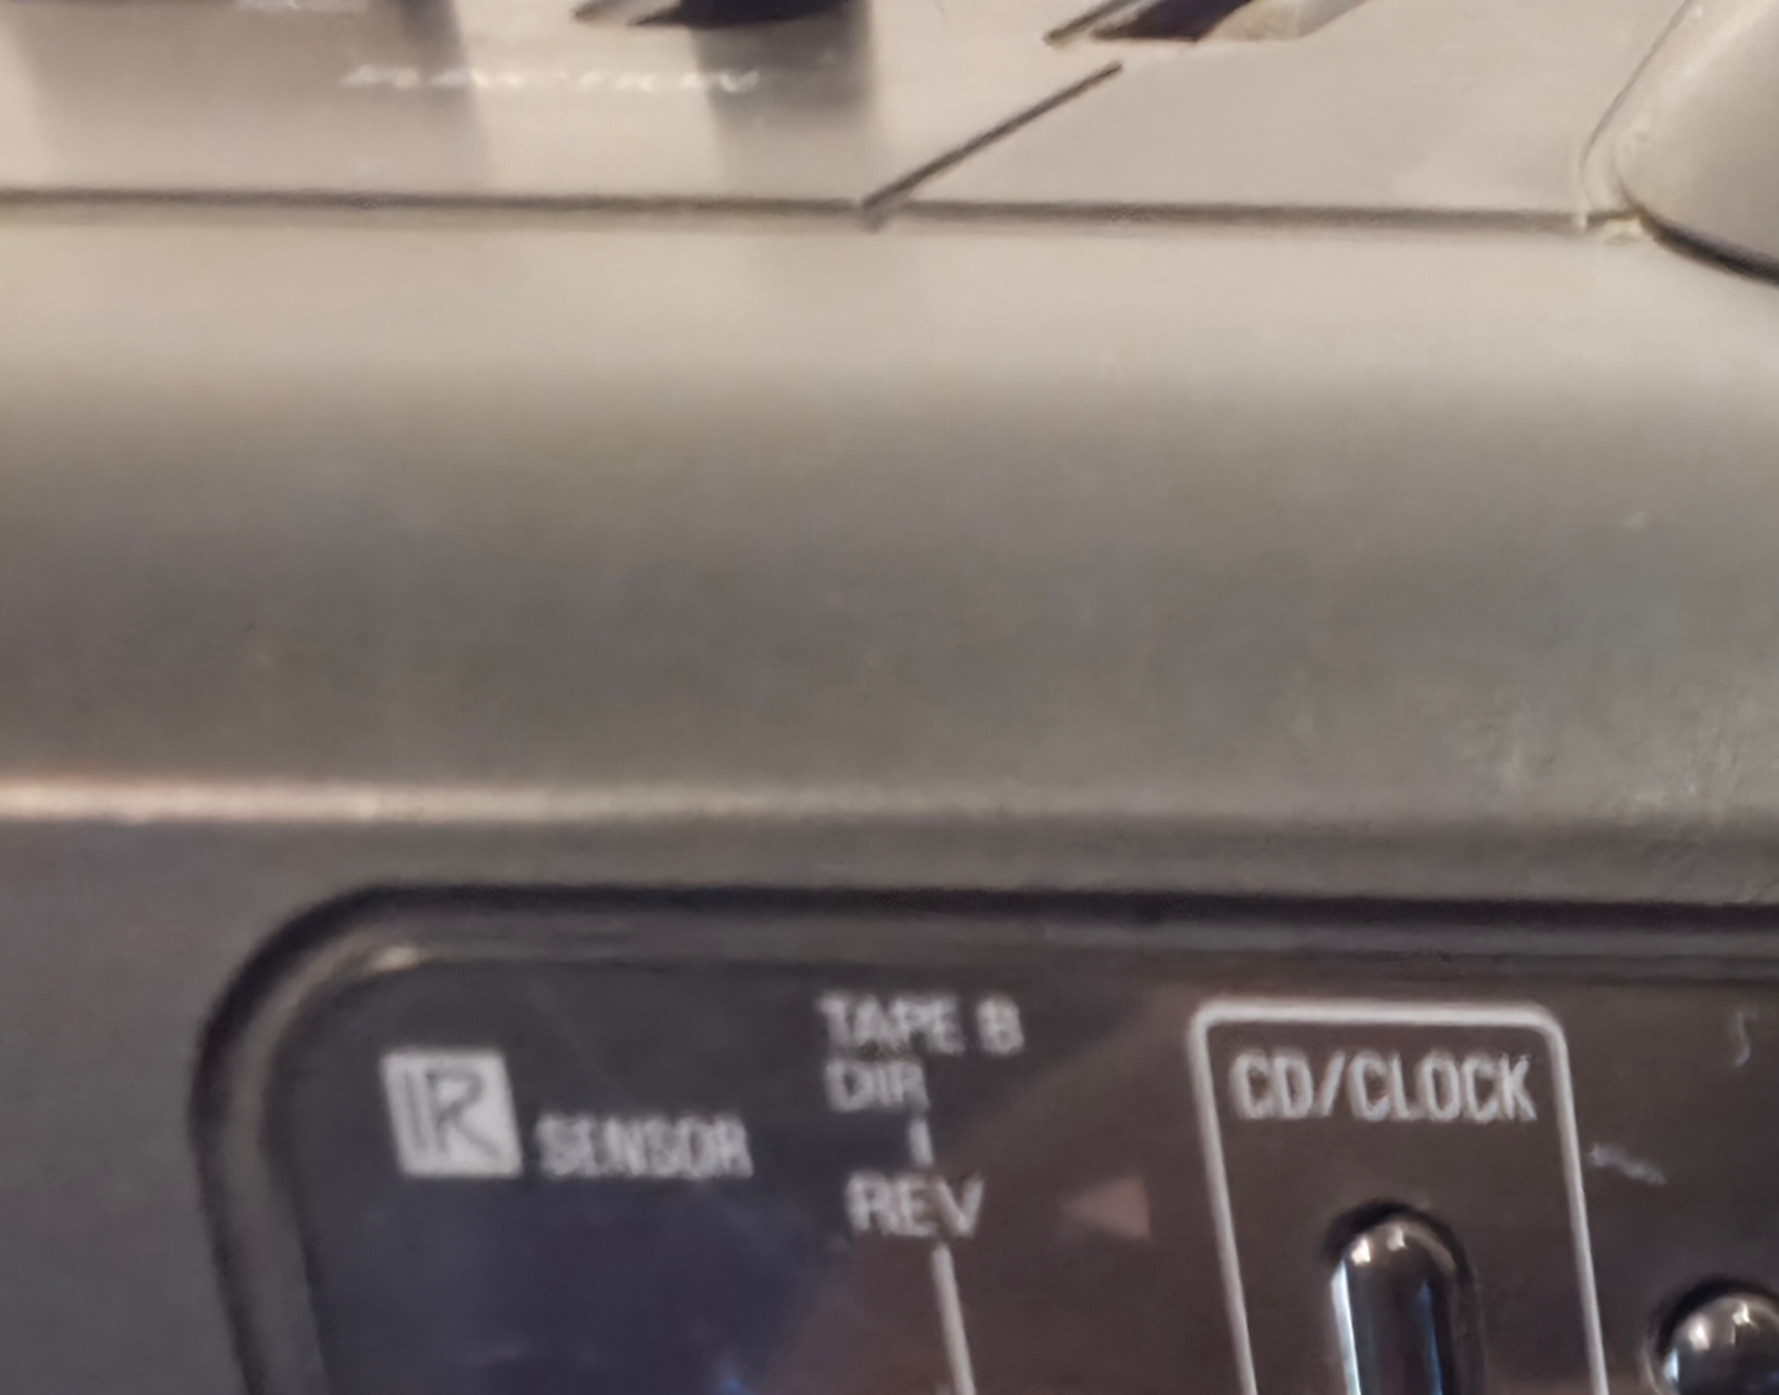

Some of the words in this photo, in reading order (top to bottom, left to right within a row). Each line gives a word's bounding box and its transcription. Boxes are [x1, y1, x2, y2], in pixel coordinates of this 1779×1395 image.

[821, 995, 958, 1052] TAPE
[826, 1058, 927, 1111] DIR
[1231, 1052, 1536, 1123] CD/CLOCK
[538, 1116, 751, 1178] SENSOR
[848, 1175, 983, 1237] REV
